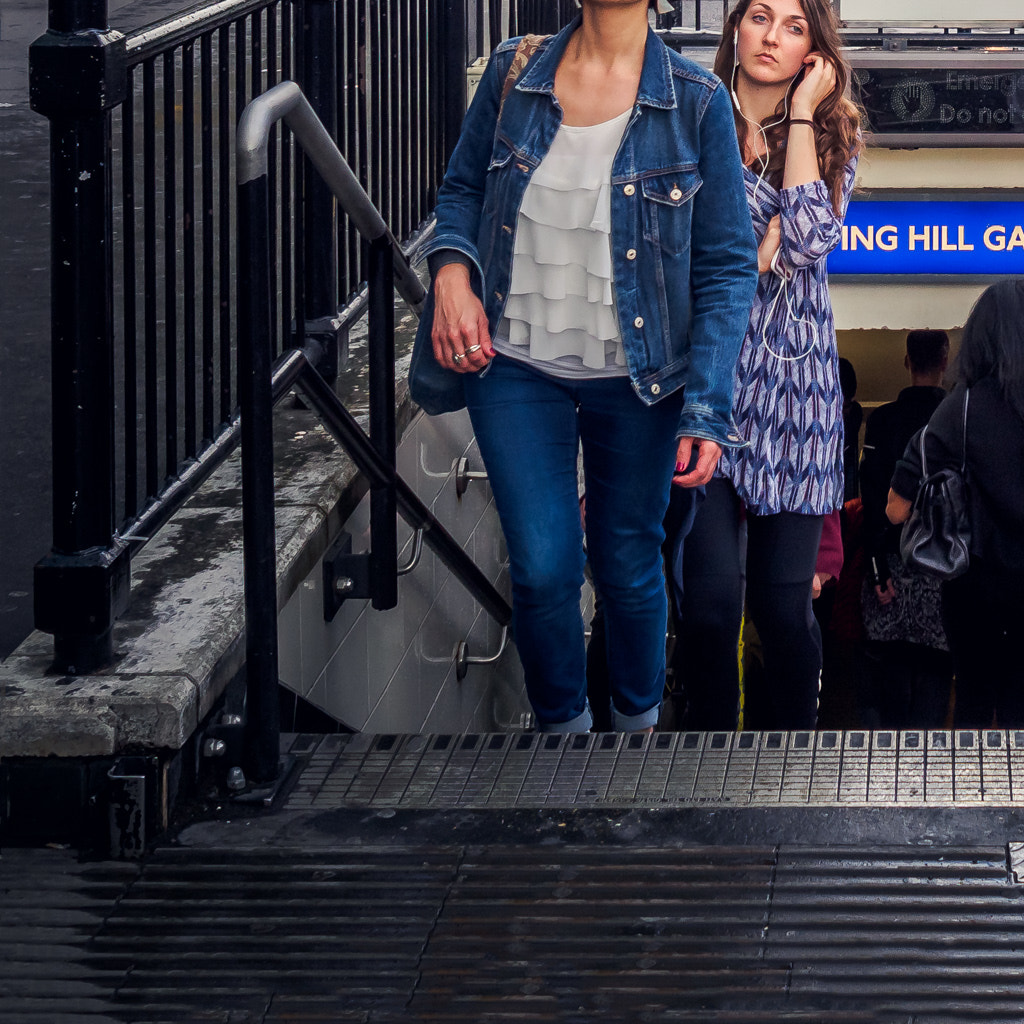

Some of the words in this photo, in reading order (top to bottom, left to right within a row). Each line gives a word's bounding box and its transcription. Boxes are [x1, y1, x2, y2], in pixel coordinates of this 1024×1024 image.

[939, 104, 972, 124] Do
[977, 104, 1016, 124] not
[908, 224, 975, 251] HILL
